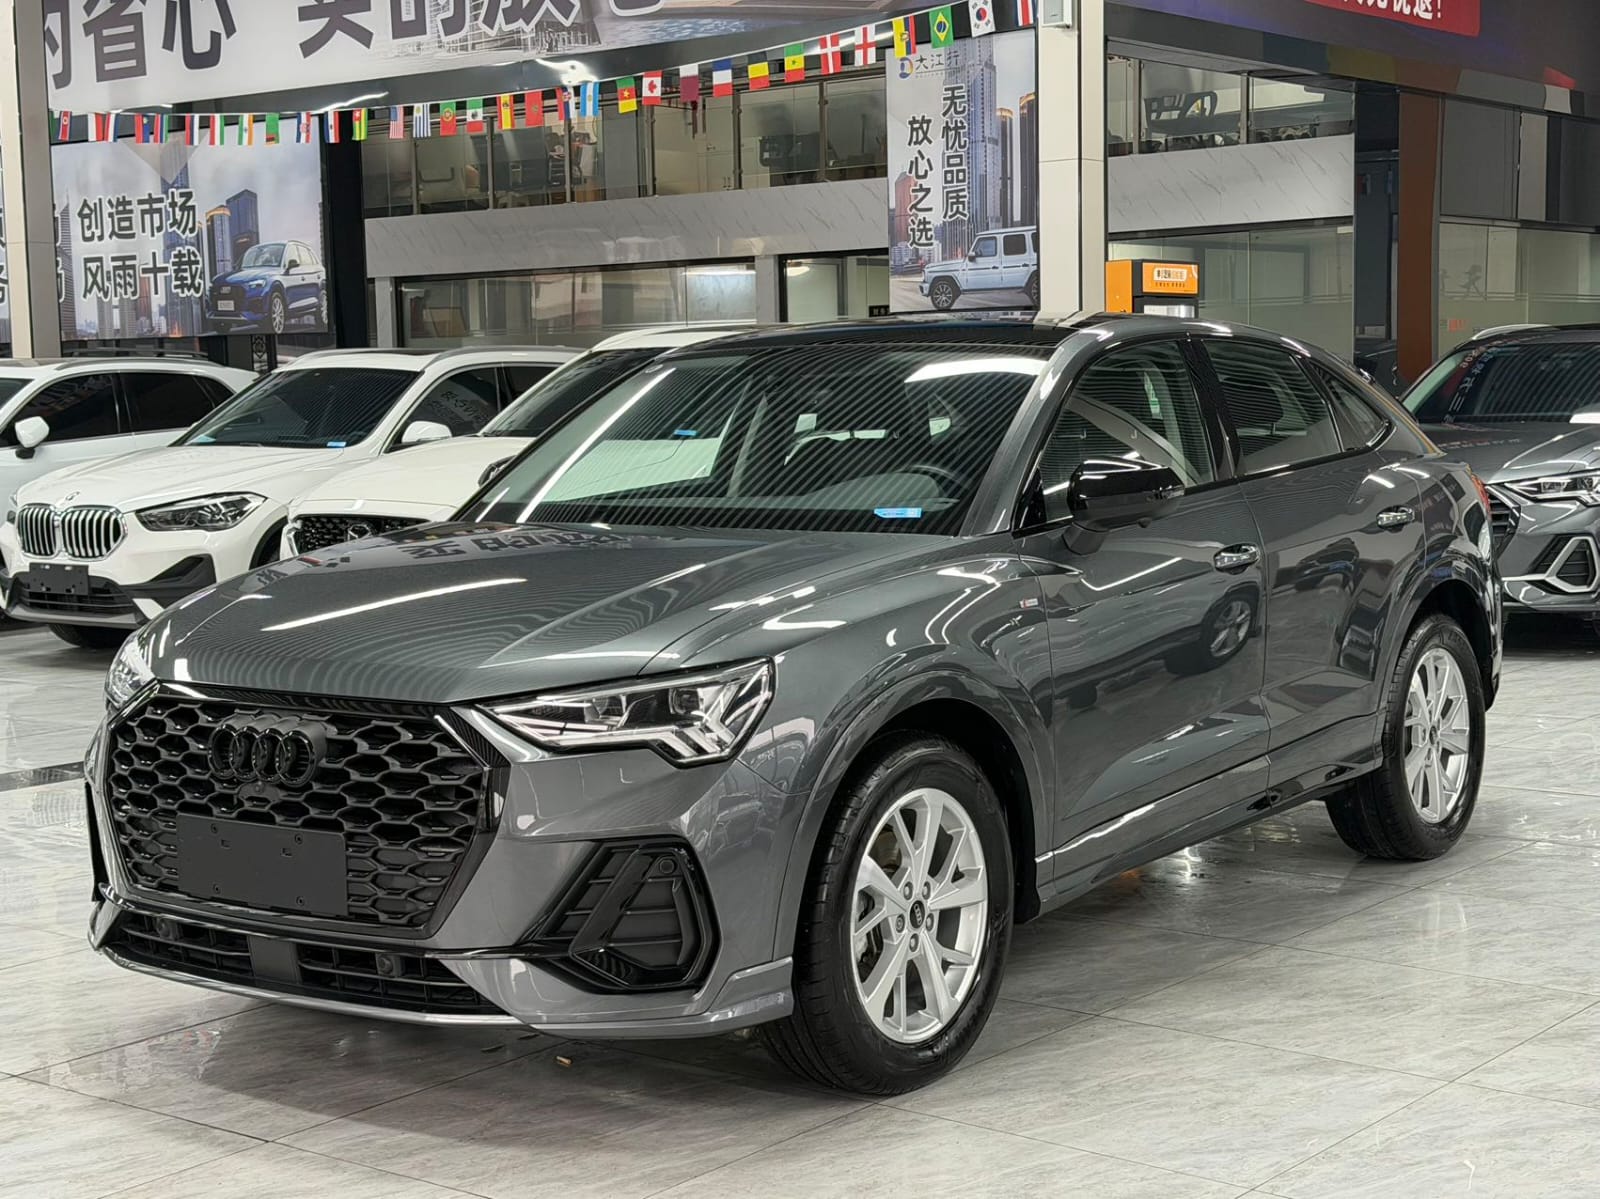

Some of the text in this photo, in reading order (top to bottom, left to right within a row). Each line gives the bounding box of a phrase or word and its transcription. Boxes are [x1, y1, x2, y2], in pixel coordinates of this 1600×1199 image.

[907, 114, 934, 248] 放心之选
[942, 84, 968, 220] 无忧品质
[77, 190, 199, 242] 创造市场
[82, 248, 203, 300] 风雨十载
